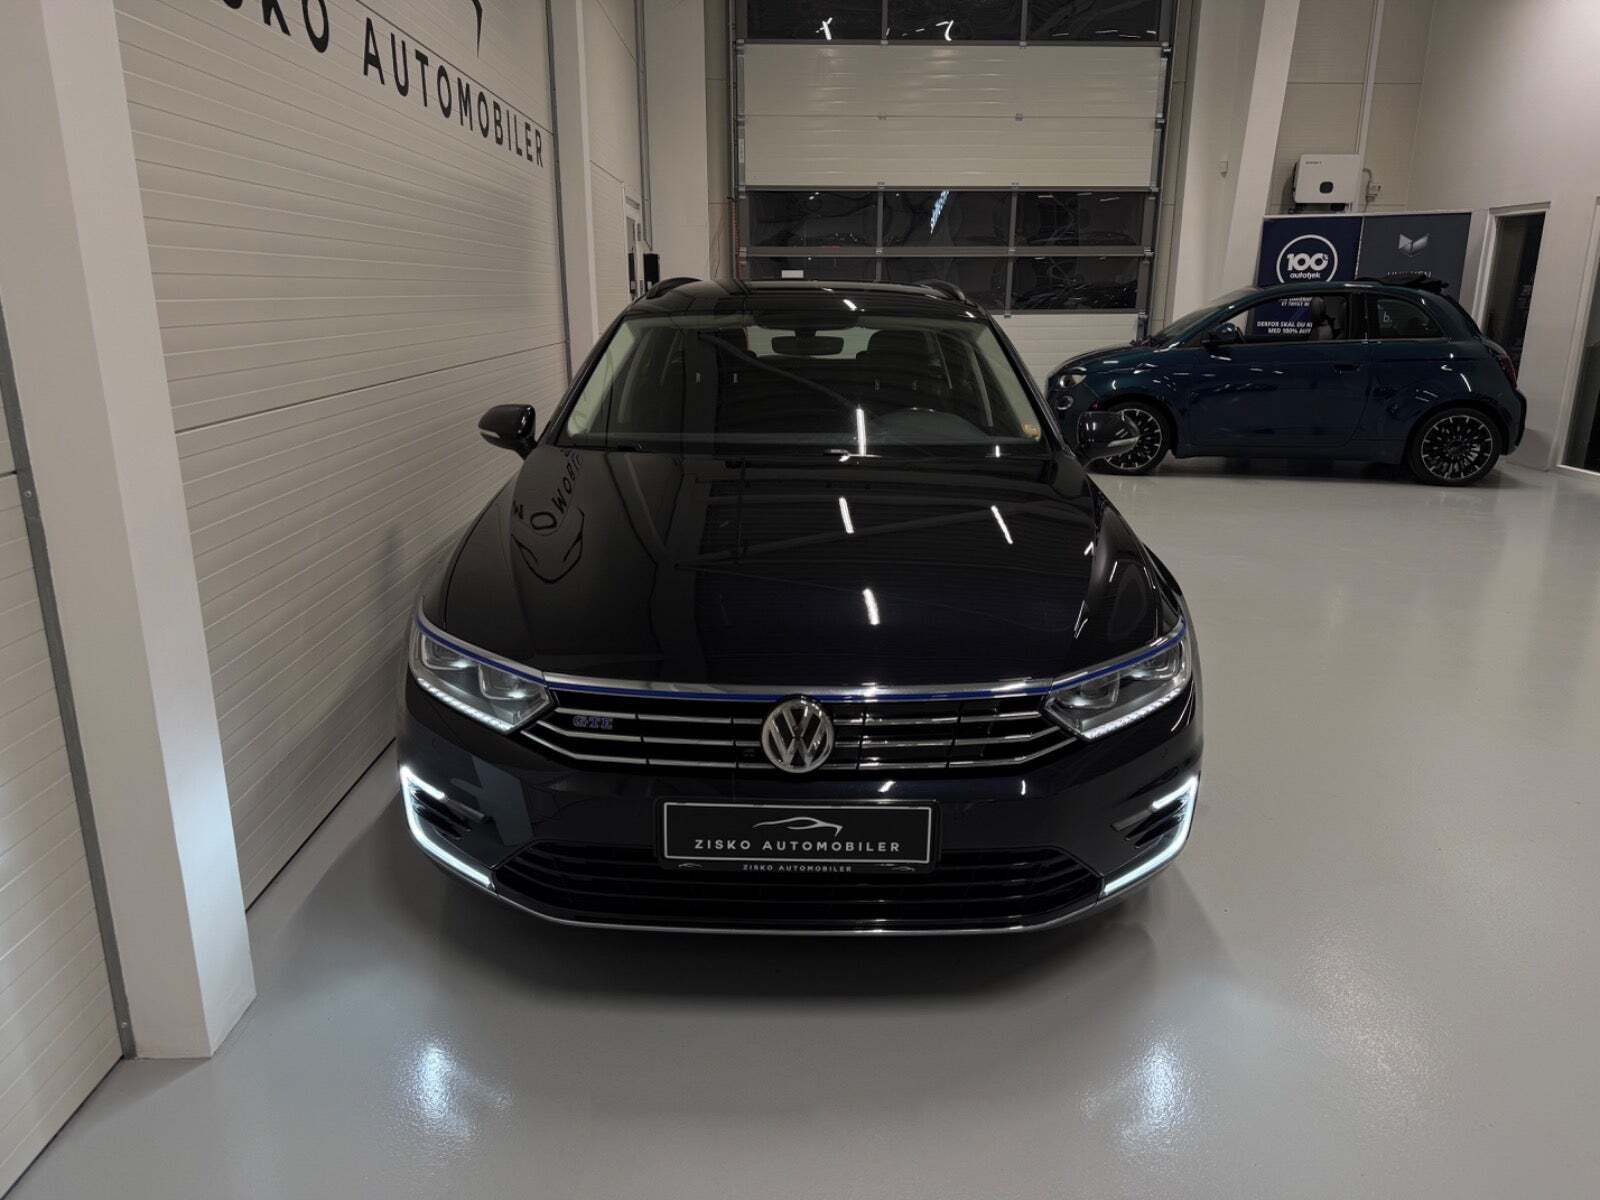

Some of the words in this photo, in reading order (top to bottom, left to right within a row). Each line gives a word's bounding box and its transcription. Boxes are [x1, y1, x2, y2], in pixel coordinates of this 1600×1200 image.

[363, 17, 543, 168] AUTOMOBILER
[694, 838, 751, 850] ZISKO
[762, 840, 901, 852] AUTOMOBILER
[743, 863, 774, 871] ZISKO
[778, 865, 852, 873] AUTOMOBILER
